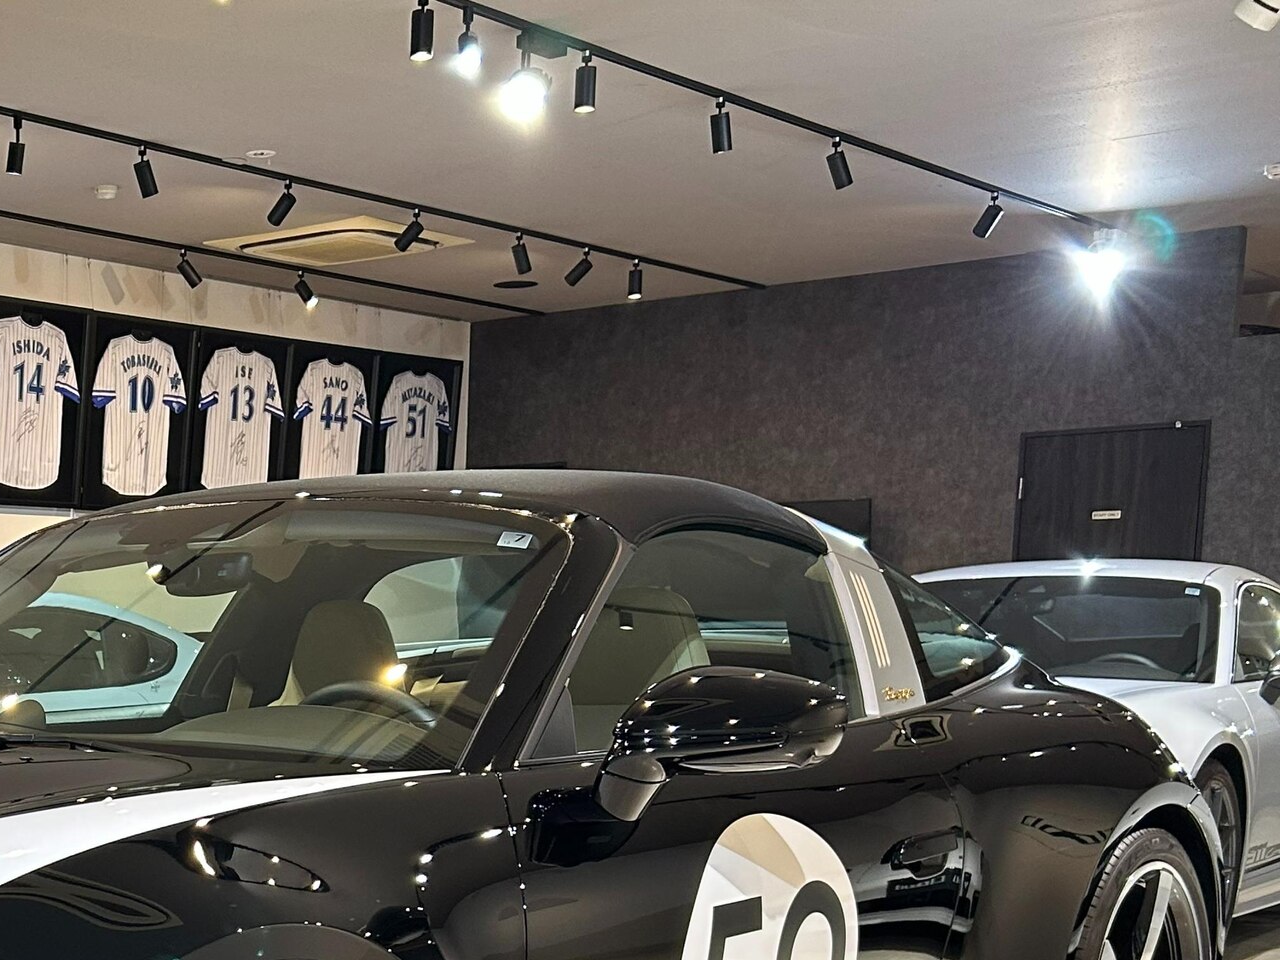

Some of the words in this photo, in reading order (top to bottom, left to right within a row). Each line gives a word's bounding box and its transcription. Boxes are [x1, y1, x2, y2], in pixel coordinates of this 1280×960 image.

[12, 339, 50, 361] ISHIDA
[13, 360, 45, 404] 14
[235, 365, 253, 380] ISE
[323, 376, 348, 391] SANO
[128, 373, 155, 413] 10
[230, 383, 256, 423] 13
[320, 394, 348, 432] 44
[405, 404, 428, 439] 51
[514, 534, 526, 542] 7
